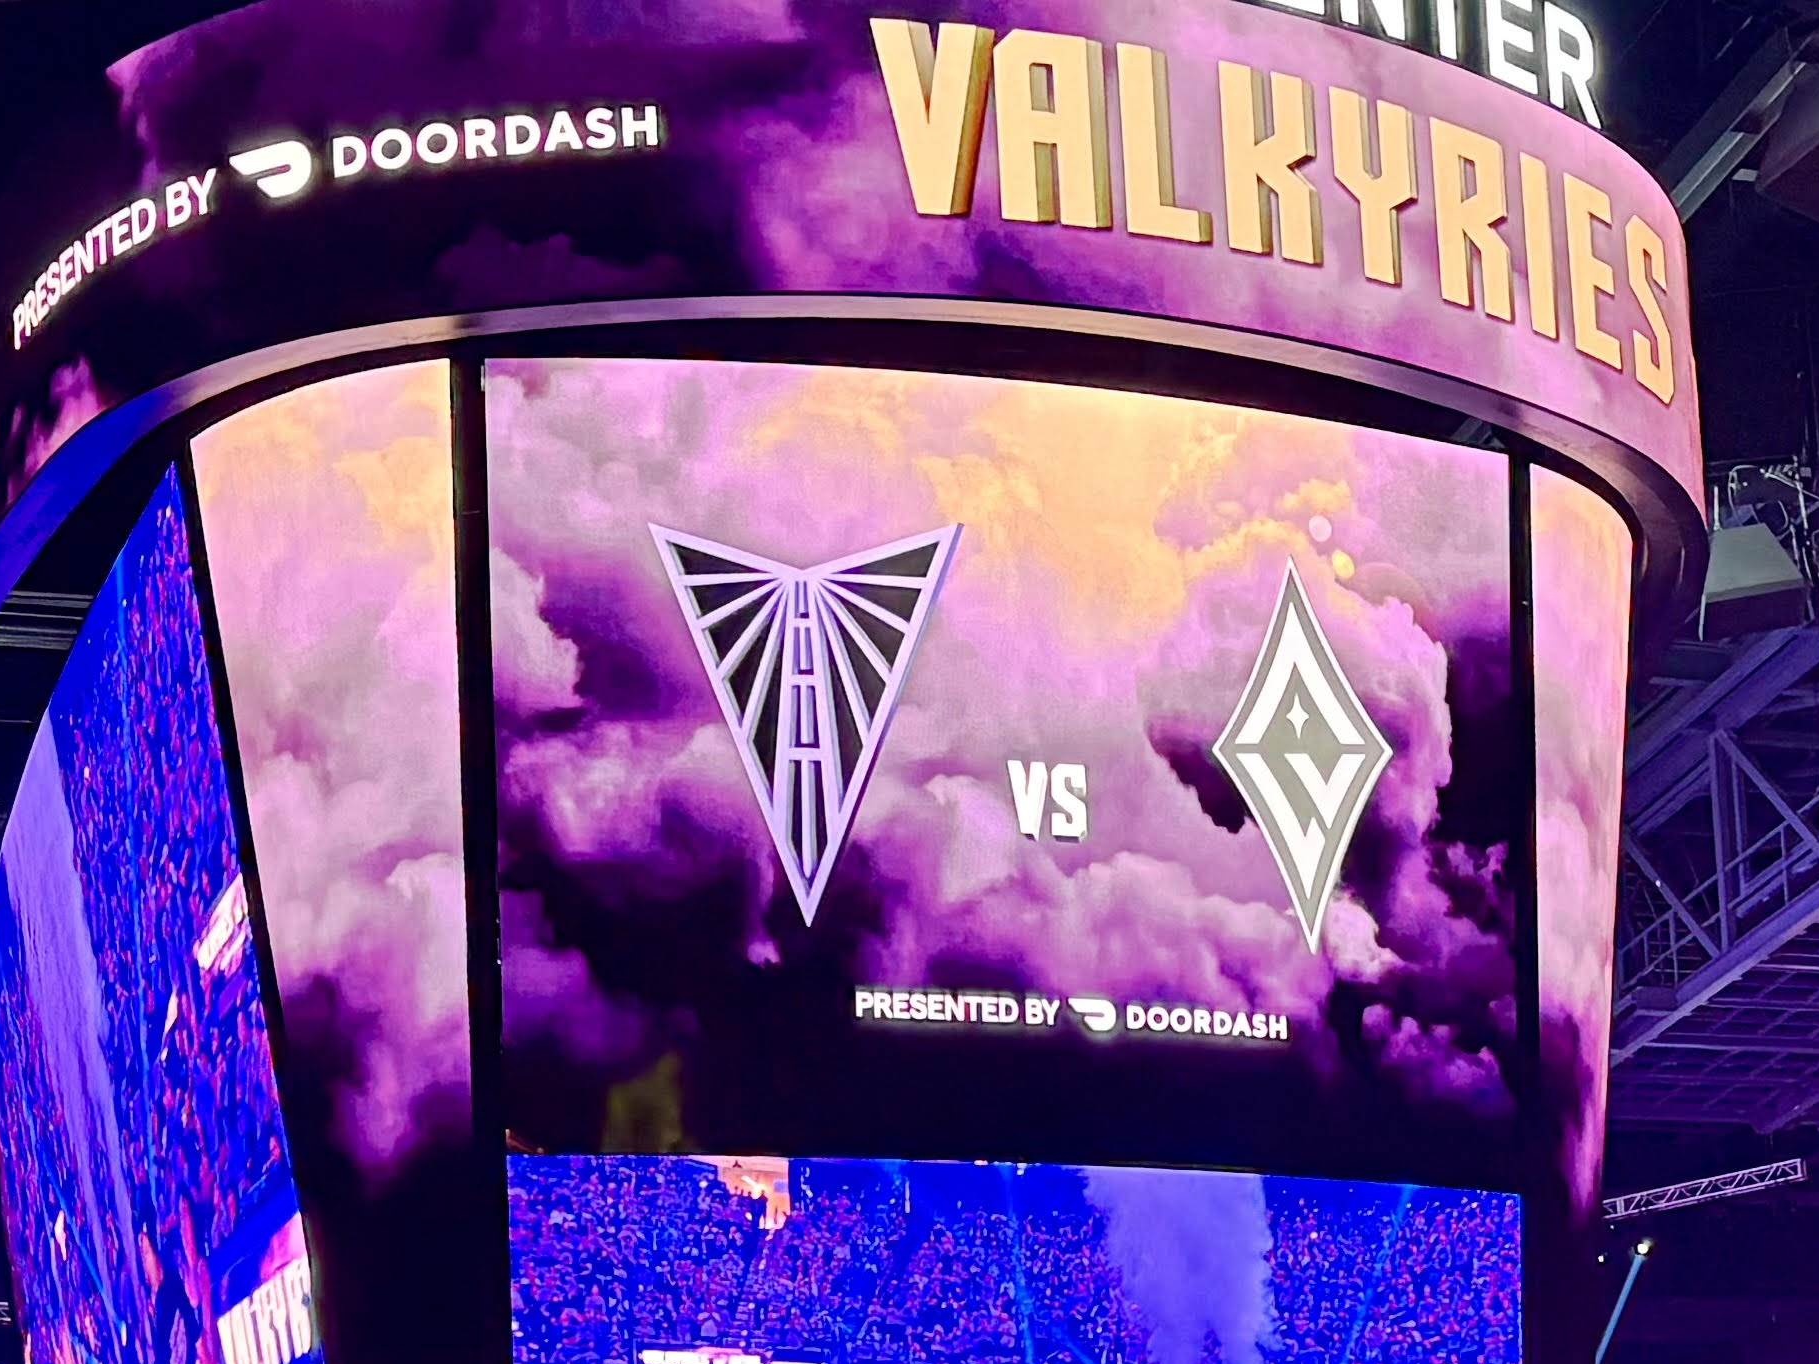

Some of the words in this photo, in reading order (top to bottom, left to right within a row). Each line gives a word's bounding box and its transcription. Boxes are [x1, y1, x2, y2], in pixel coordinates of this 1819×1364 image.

[12, 197, 157, 350] PRESENTED
[165, 167, 217, 229] BY
[332, 104, 659, 179] DOORDASH
[869, 17, 1674, 405] VALKYRIES
[1007, 760, 1088, 843] VS
[855, 990, 1020, 1024] PRESENTED
[1024, 998, 1060, 1026] BY
[1126, 1004, 1288, 1040] DOORDASH
